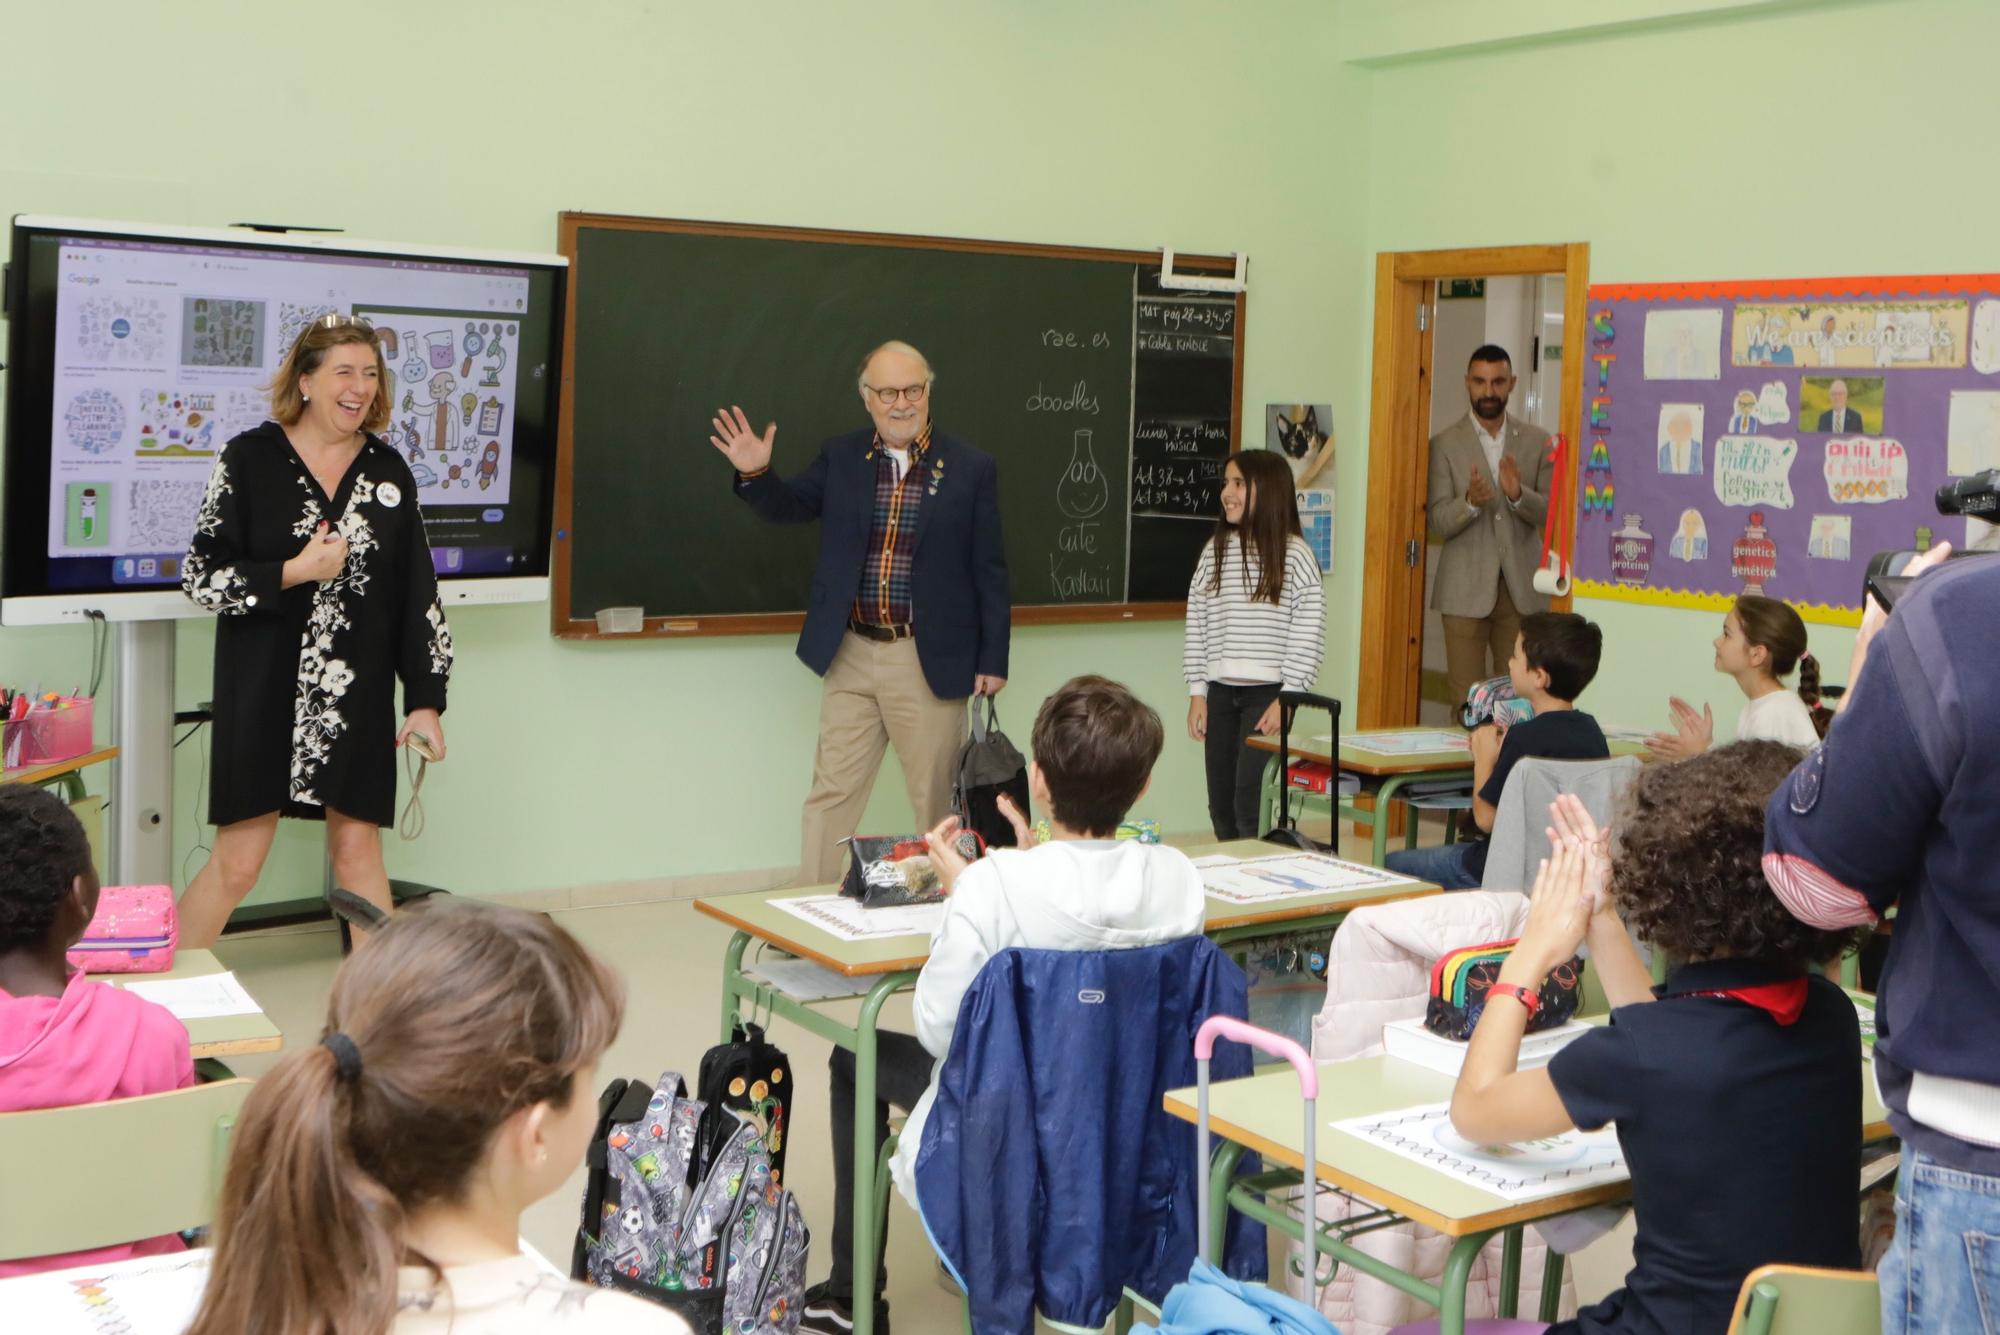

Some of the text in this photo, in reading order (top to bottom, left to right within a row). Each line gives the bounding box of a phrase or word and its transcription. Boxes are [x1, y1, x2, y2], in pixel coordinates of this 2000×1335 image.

[67, 272, 101, 287] Google
[1140, 304, 1160, 319] MAT
[1746, 322, 1953, 348] We are scientists
[1026, 379, 1100, 415] doodles
[1583, 308, 1617, 523] STEAM
[1135, 421, 1169, 441] Lunes
[1615, 542, 1647, 556] protein
[1732, 544, 1776, 559] genetics
[1731, 562, 1776, 579] genética
